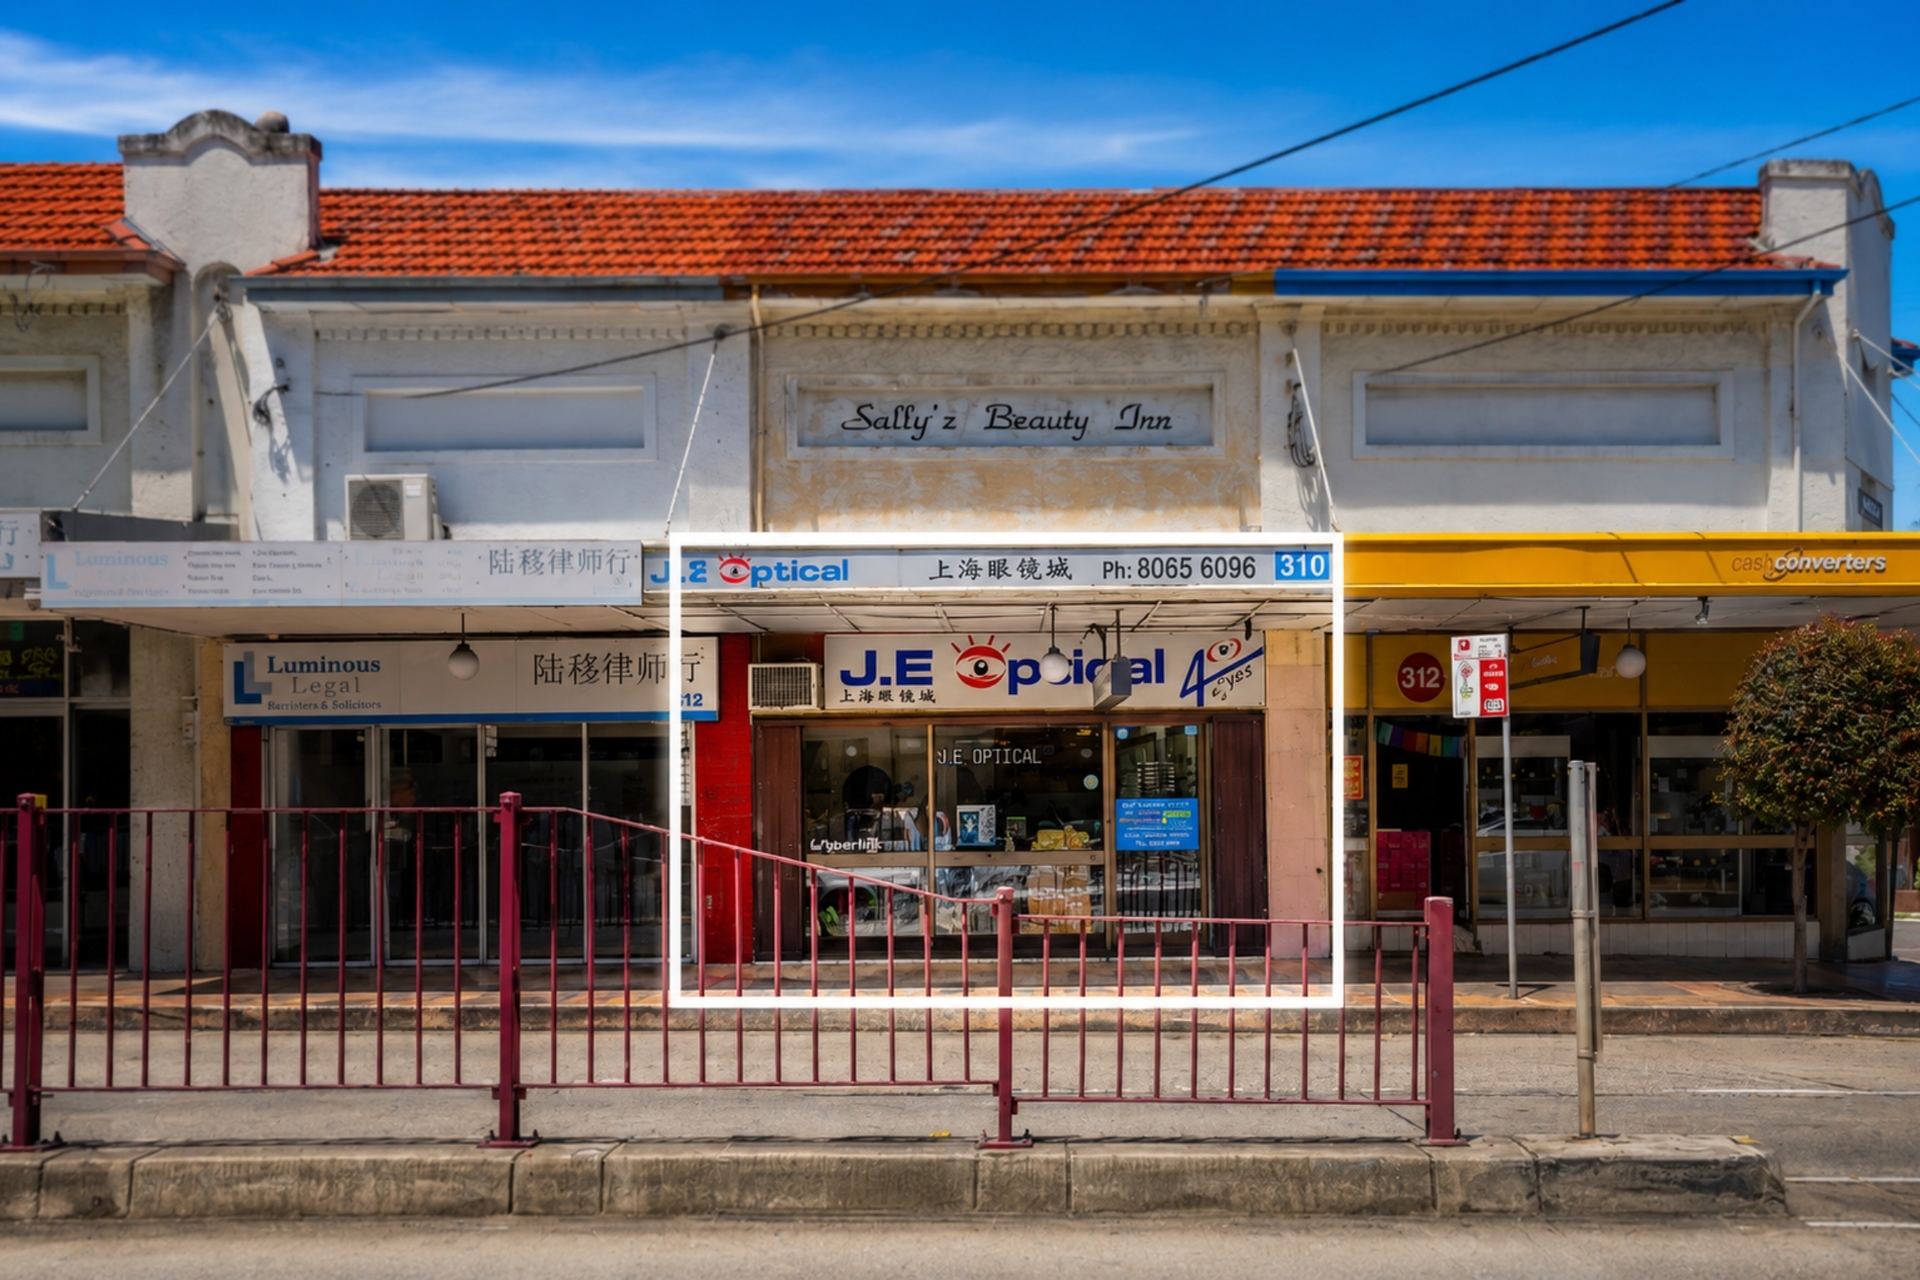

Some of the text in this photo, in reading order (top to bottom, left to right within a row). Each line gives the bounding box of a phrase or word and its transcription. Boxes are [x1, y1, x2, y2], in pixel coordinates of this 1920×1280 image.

[841, 403, 1173, 441] Sally'z Beauty Inn
[75, 551, 169, 567] Luminous
[928, 556, 1073, 581] 上海眼镜城
[1102, 556, 1256, 580] Ph: 8065 6096
[1280, 554, 1325, 577] 310
[1774, 553, 1887, 573] converters
[267, 656, 381, 674] Luminous
[839, 649, 934, 687] J.E
[291, 676, 361, 698] Legal
[1401, 667, 1440, 689] 312
[331, 700, 382, 710] Solicitors
[680, 692, 704, 707] 12
[972, 748, 1042, 764] OPTICAL
